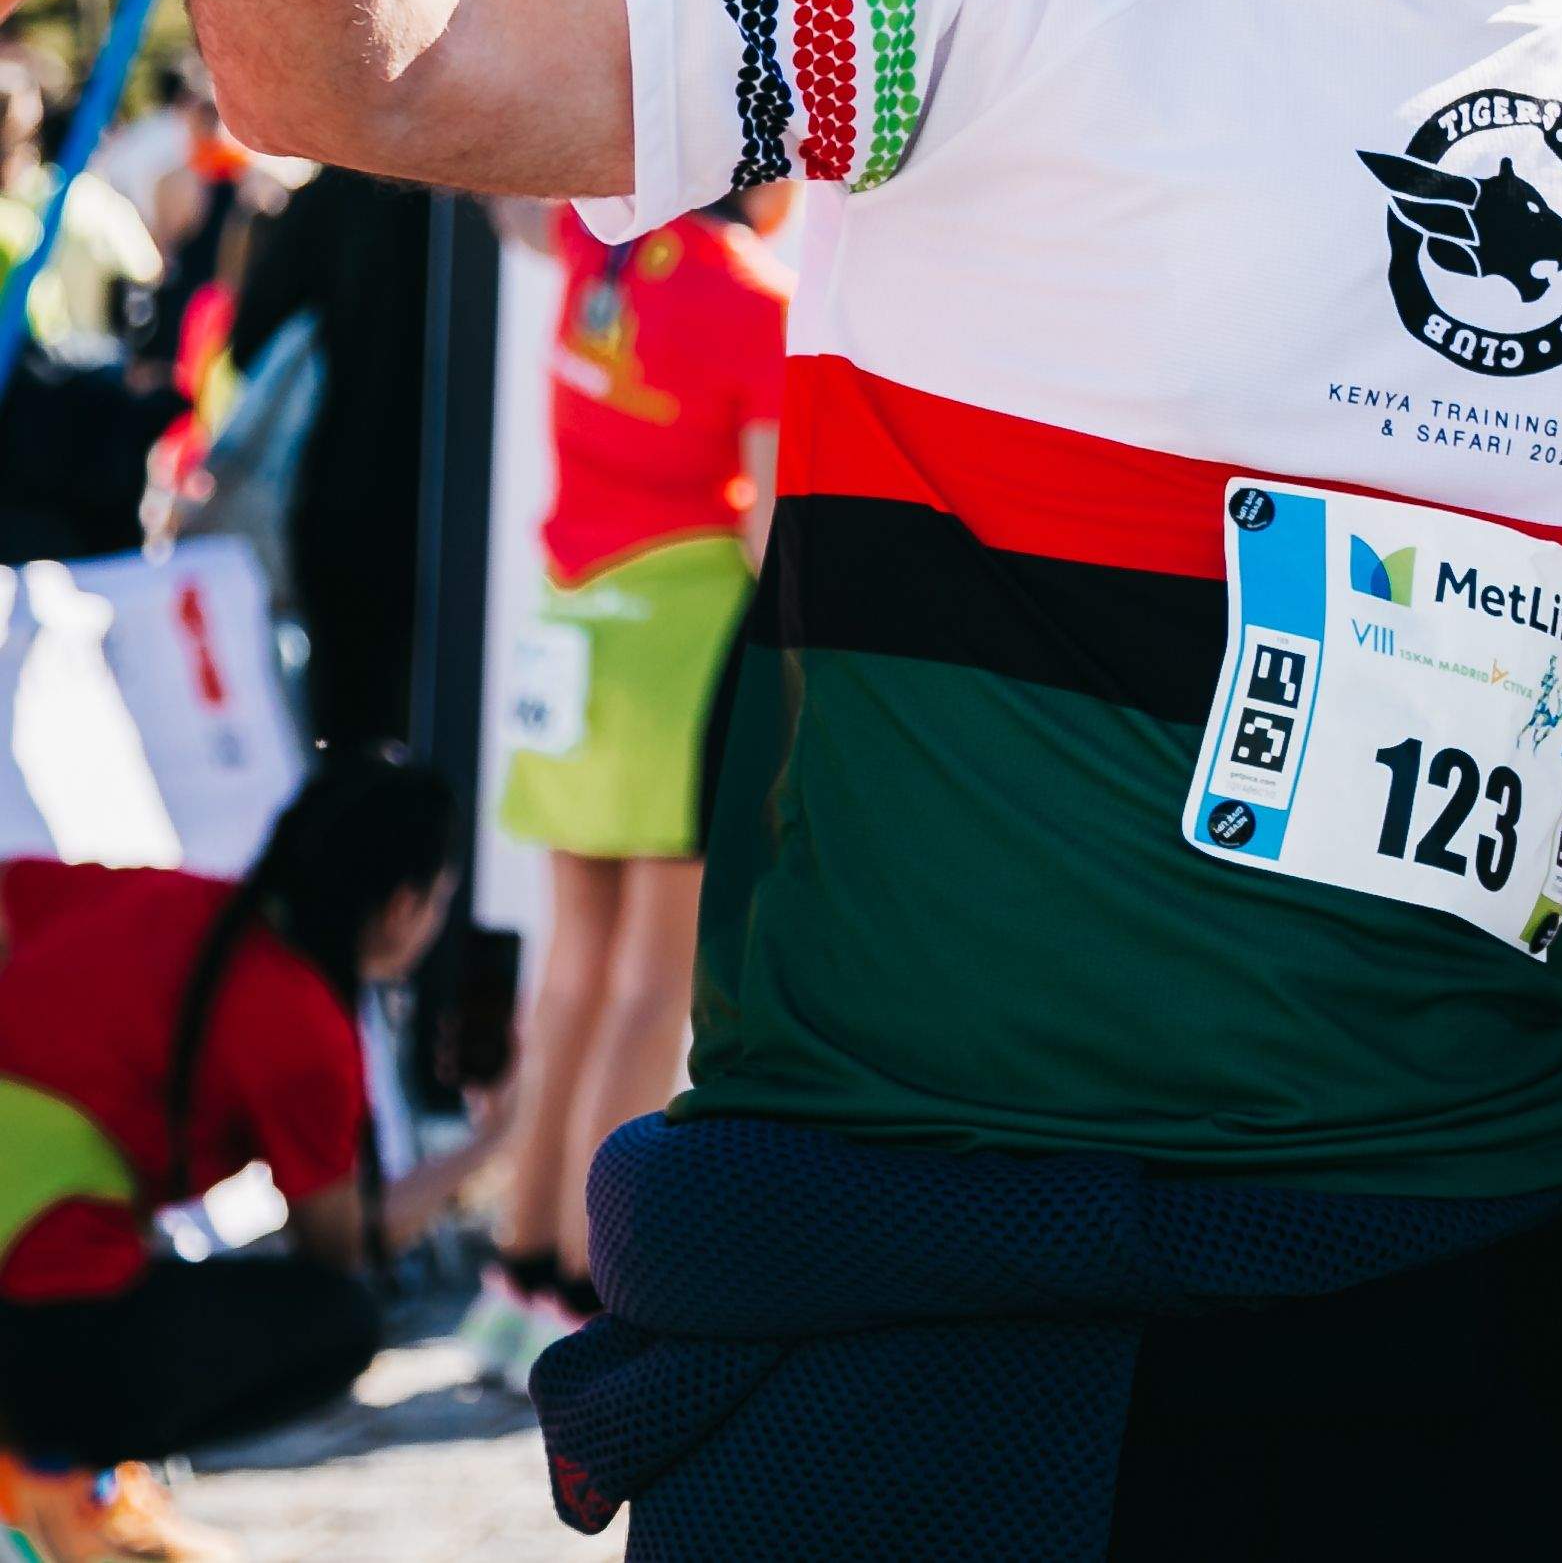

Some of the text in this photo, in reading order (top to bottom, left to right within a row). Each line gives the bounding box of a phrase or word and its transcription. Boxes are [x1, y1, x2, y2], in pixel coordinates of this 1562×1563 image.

[1437, 96, 1562, 142] TIGERS
[1423, 313, 1525, 369] CLUB
[1328, 383, 1411, 413] KENYA
[1431, 400, 1559, 438] TRAINING
[1381, 419, 1394, 437] &
[1417, 425, 1512, 456] SAFARI
[1351, 617, 1394, 656] VIII
[1399, 648, 1434, 667] 15KM
[1438, 660, 1489, 683] MADRID
[1374, 737, 1524, 893] 123
